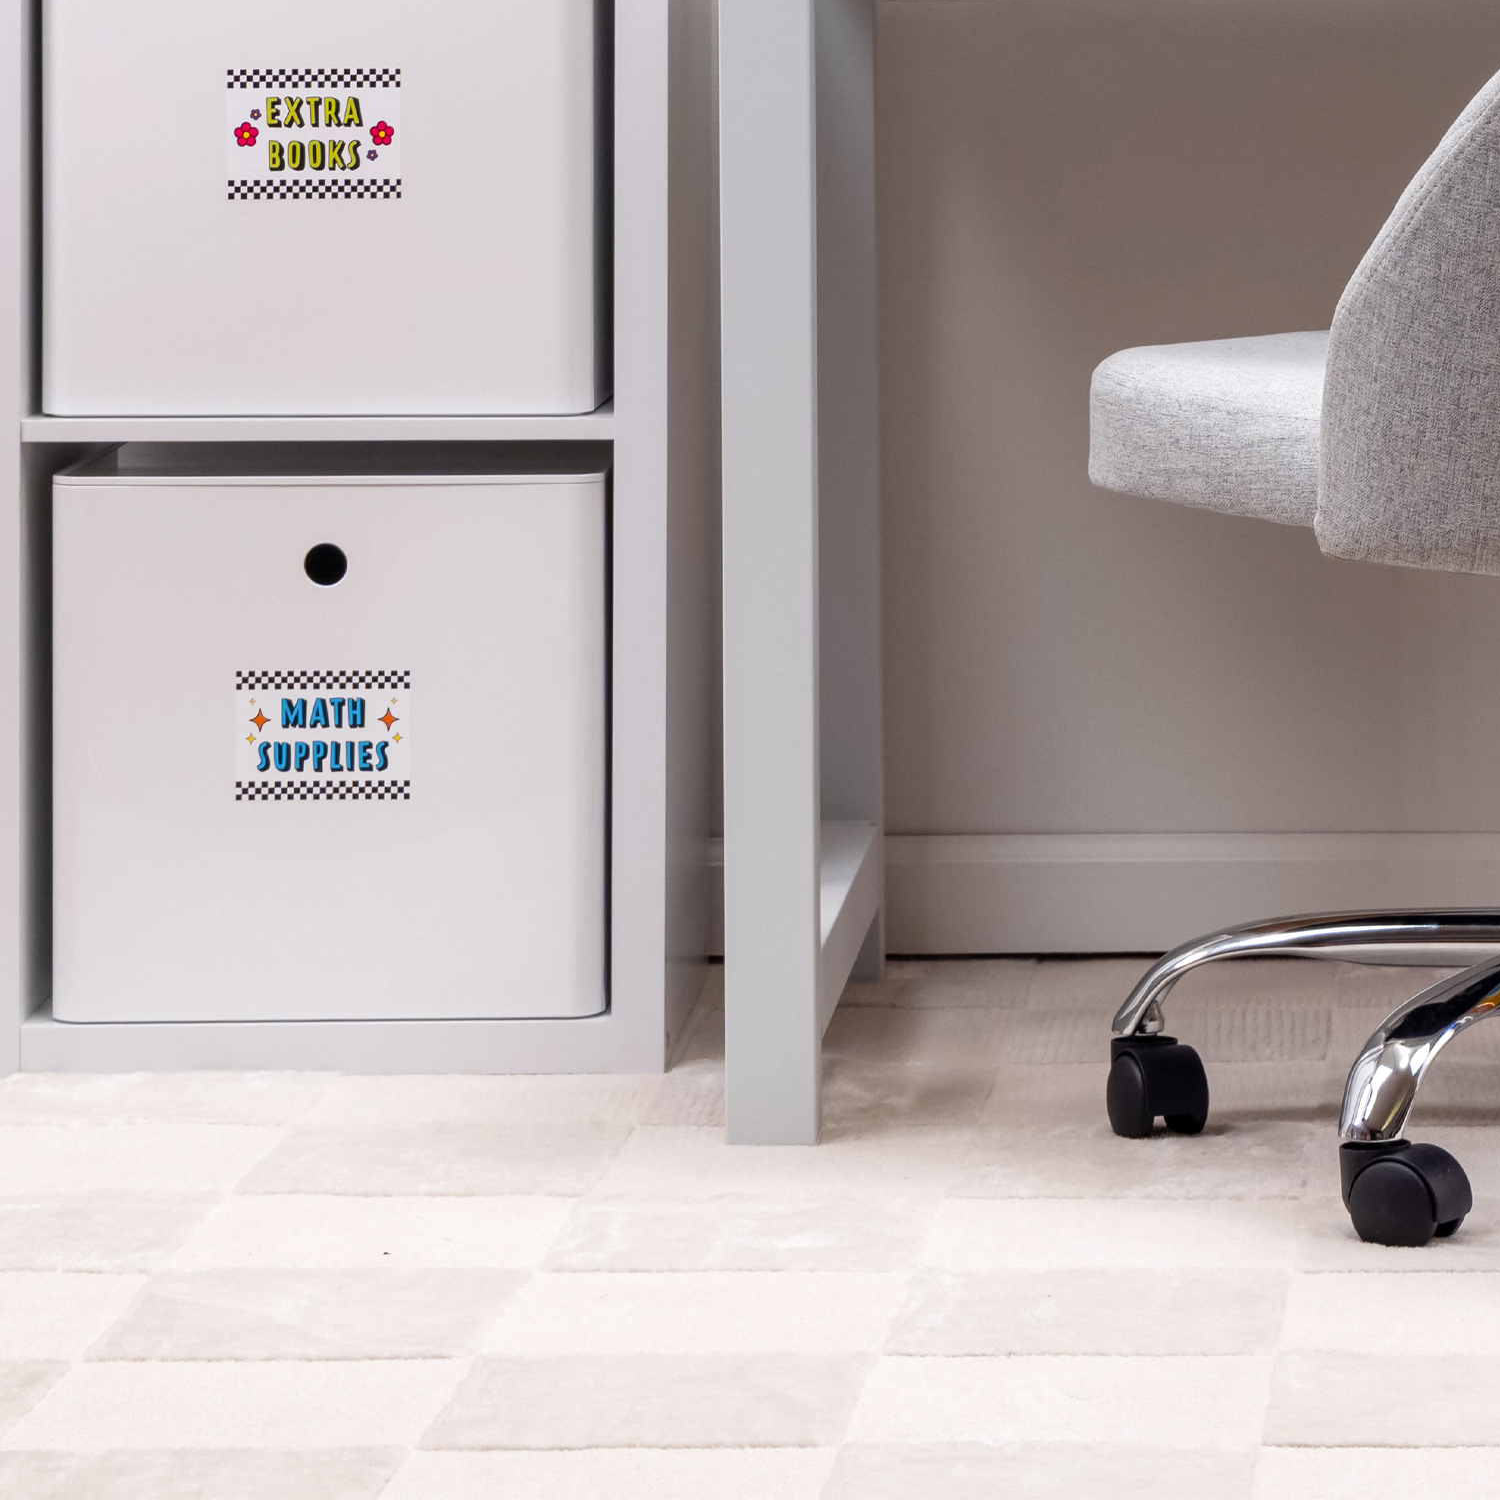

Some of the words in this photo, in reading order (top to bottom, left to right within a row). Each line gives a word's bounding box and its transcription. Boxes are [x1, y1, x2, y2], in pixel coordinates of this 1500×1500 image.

[265, 96, 364, 128] EXTRA
[268, 140, 362, 171] BOOKS
[280, 696, 366, 729] MATH
[256, 740, 390, 773] SUPPLIES
